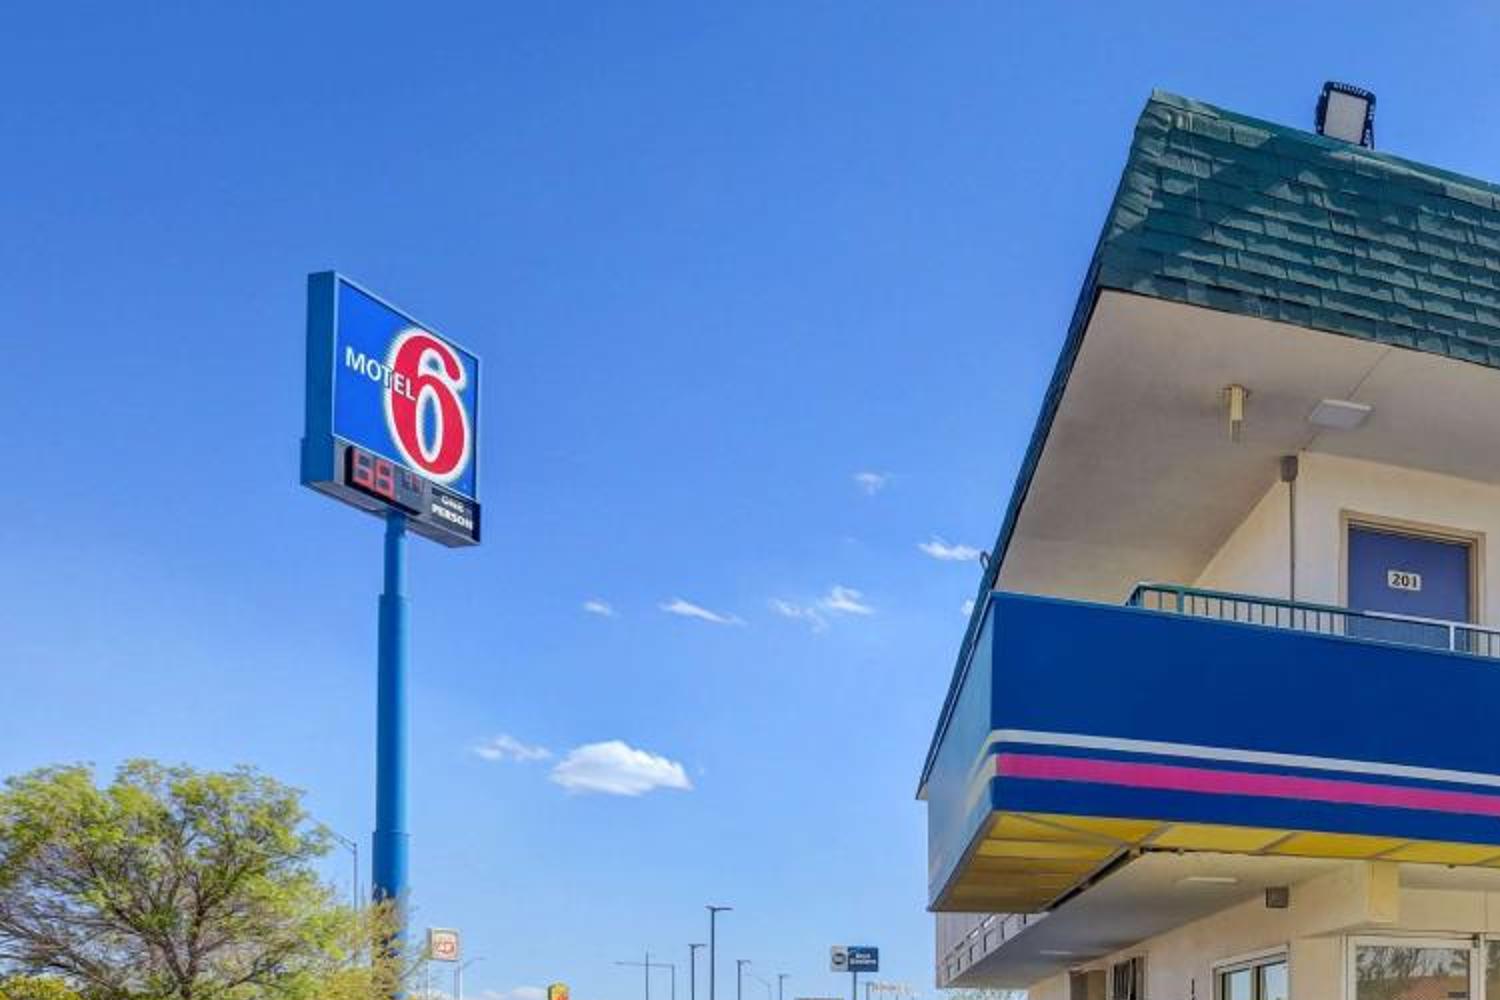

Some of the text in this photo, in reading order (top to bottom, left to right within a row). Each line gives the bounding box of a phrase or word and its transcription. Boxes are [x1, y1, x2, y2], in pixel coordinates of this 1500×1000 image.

[345, 328, 469, 485] MOTEL 6
[1391, 572, 1417, 588] 201
